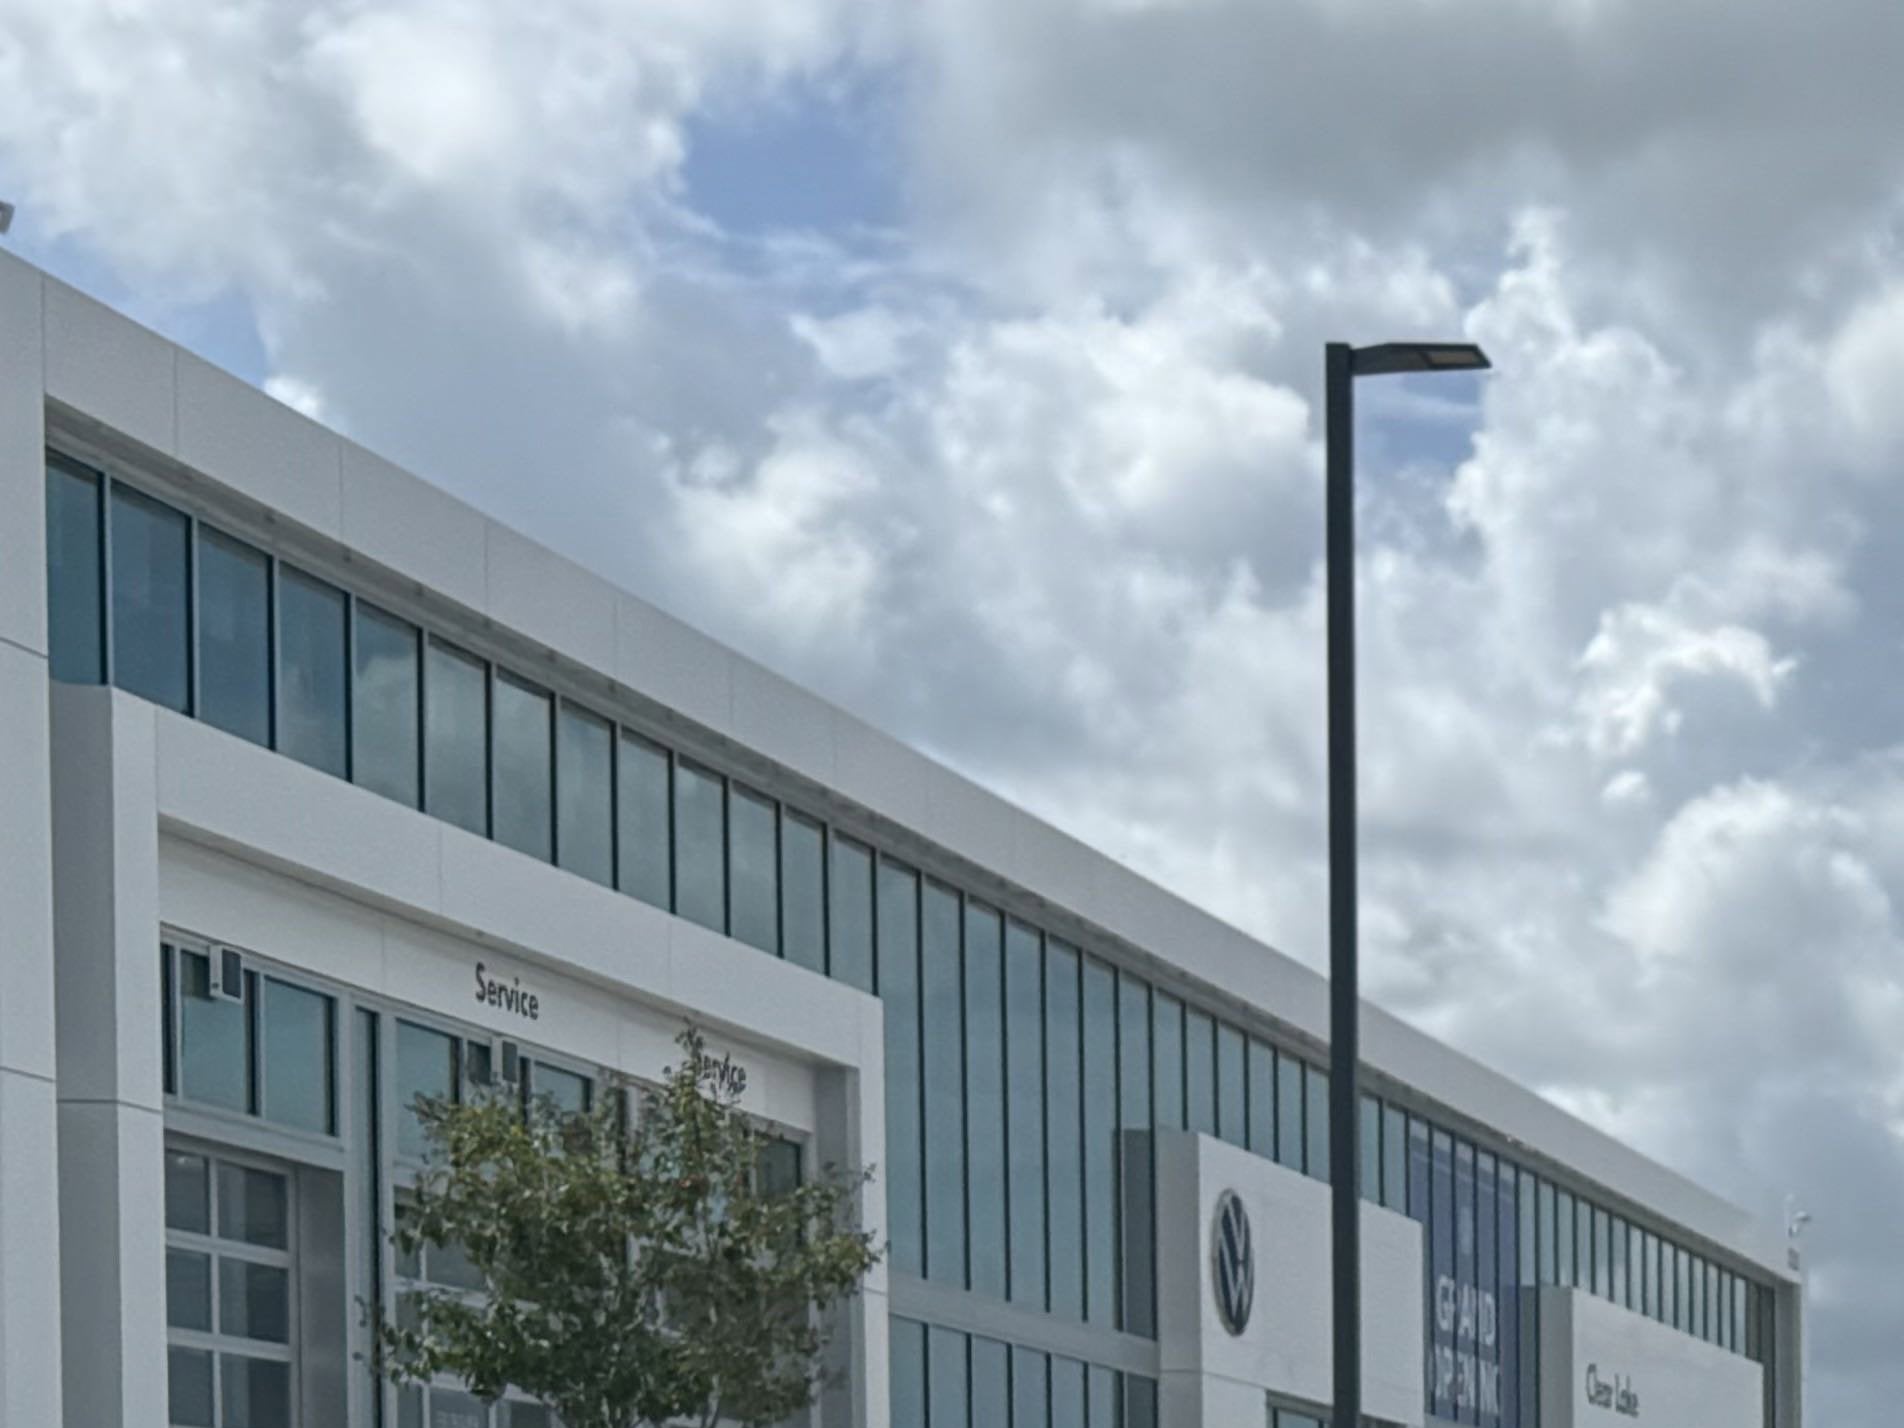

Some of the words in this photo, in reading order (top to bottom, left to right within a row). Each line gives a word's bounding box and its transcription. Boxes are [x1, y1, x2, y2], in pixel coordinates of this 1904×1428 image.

[475, 961, 540, 1021] Service
[693, 1044, 747, 1093] ervice
[1585, 1363, 1613, 1409] Clear
[1614, 1373, 1640, 1419] Lake
